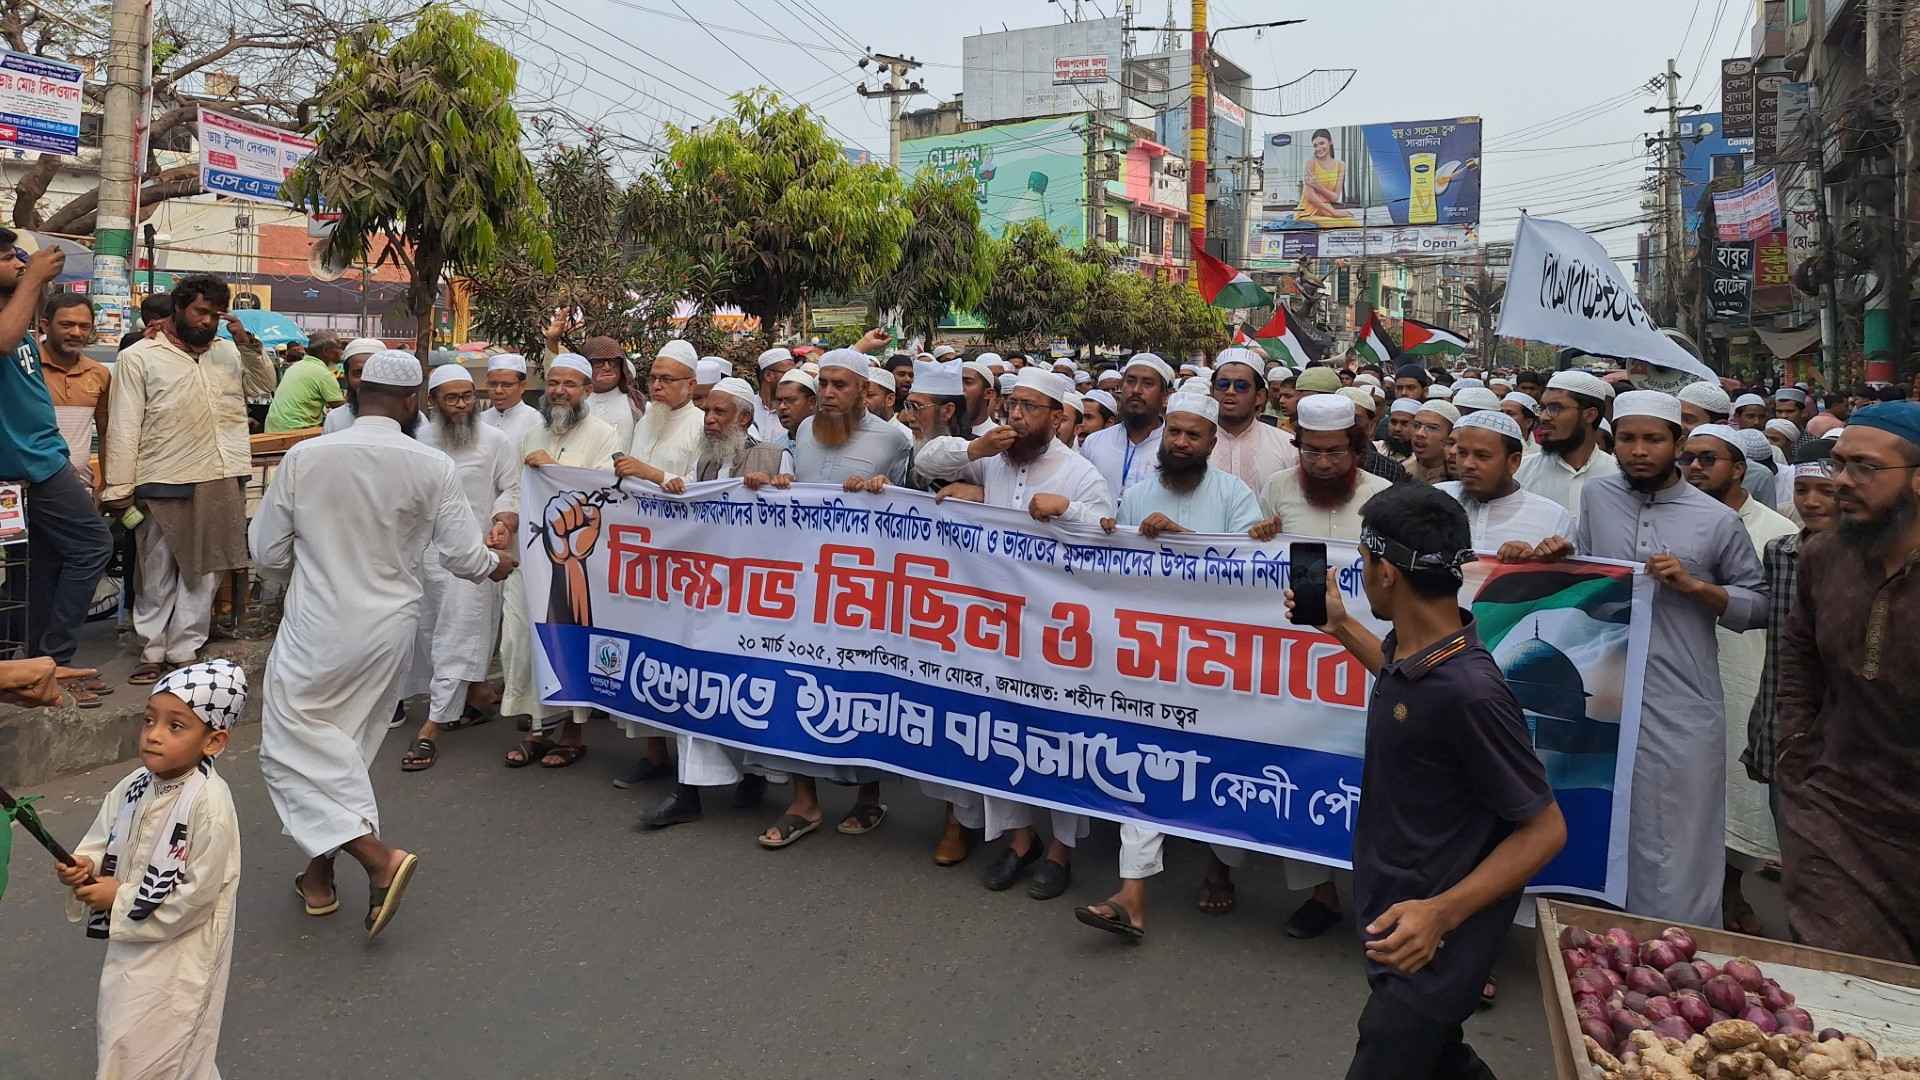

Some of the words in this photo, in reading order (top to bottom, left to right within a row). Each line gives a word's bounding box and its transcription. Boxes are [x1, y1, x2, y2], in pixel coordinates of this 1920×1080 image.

[1728, 138, 1754, 147] Comp
[1423, 239, 1457, 252] Open
[1717, 247, 1750, 271] হাবুর
[1713, 276, 1747, 296] হোটেল
[756, 494, 786, 535] উপর
[790, 497, 871, 539] ইসরাইলিদের
[874, 502, 932, 542] বর্বরোচিত
[936, 517, 984, 558] গণহত্যা
[988, 533, 1000, 557] ও
[1003, 530, 1057, 566] ভারতের
[1063, 541, 1157, 578] মুসলমানদের
[1160, 543, 1200, 581] উপর
[1204, 546, 1246, 589] নির্মম
[607, 524, 804, 619] বিক্ষোভ
[814, 543, 1026, 659] মিছিল
[1042, 601, 1094, 669] ও
[1113, 609, 1366, 708] সমাবে
[738, 633, 756, 651] ২০
[761, 633, 786, 652] মার্চ
[919, 659, 941, 682] বাদ
[1064, 680, 1105, 713] শহীদ
[1110, 691, 1156, 718] মিনার
[1160, 703, 1199, 729] চত্বর
[629, 651, 777, 730] হেফাজতে
[785, 668, 934, 748] ইসলাম
[945, 710, 1212, 804] বাংলাদেশ
[1211, 765, 1300, 821] ফেনী
[1308, 777, 1361, 833] পৌ
